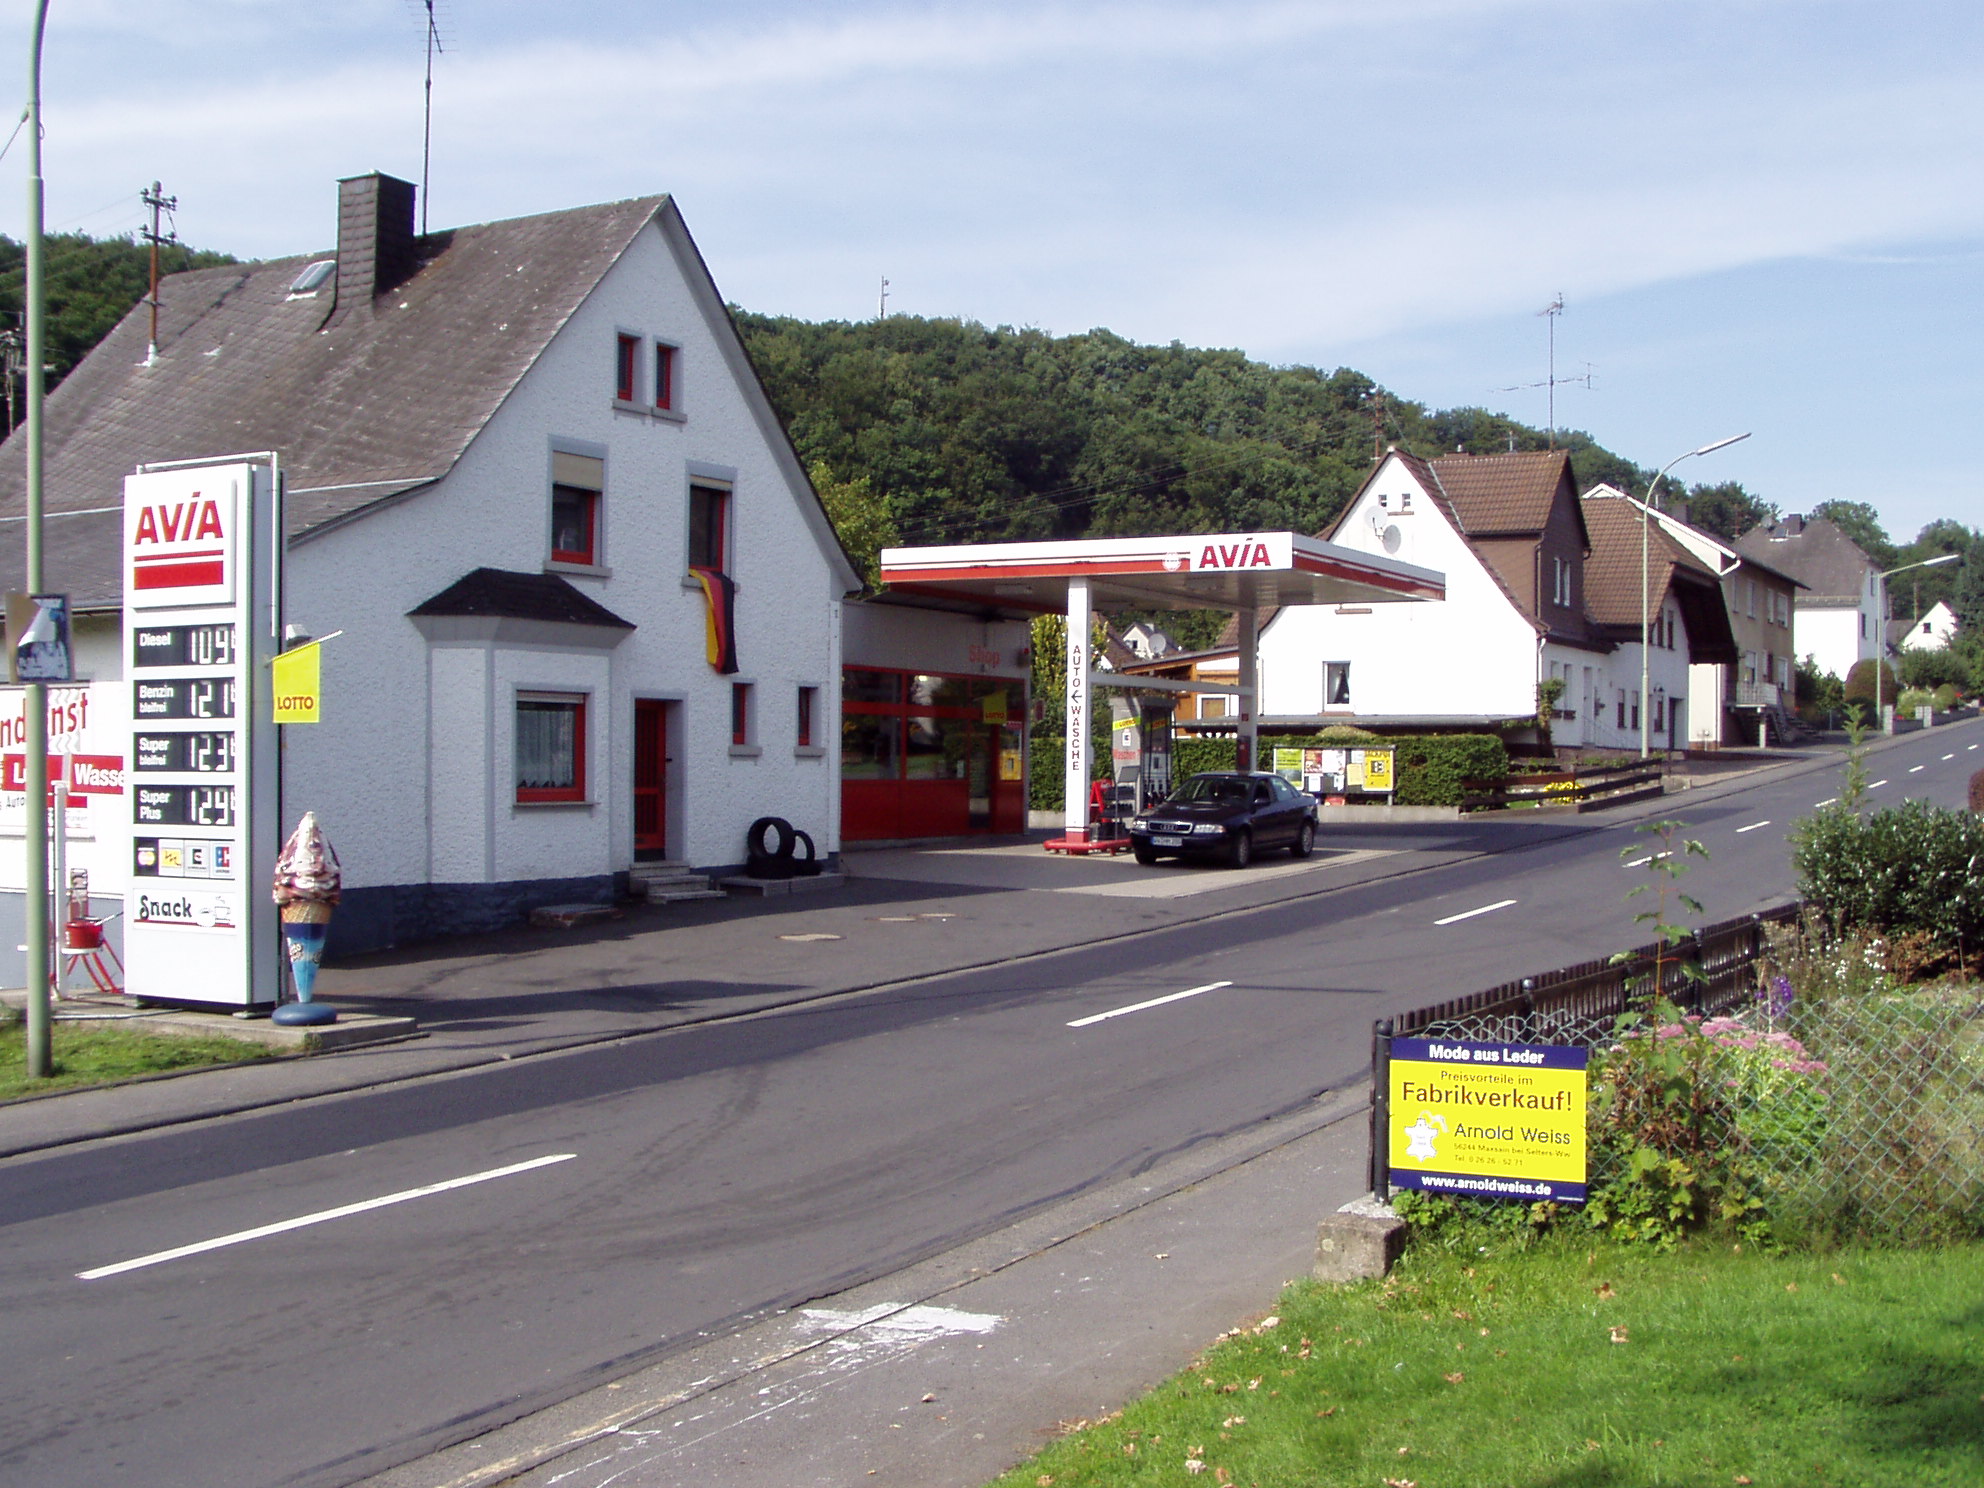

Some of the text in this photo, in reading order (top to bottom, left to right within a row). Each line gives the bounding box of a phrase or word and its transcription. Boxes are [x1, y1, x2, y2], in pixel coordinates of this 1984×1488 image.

[139, 631, 171, 647] Diesel
[1072, 645, 1082, 688] AUTO
[139, 683, 174, 699] Benzin
[277, 696, 314, 710] LOTTO
[139, 737, 170, 753] Super
[140, 789, 171, 806] Super
[140, 806, 162, 820] Plus
[140, 894, 192, 920] Snack
[1429, 1044, 1545, 1065] Mode aus Leder
[1441, 1070, 1533, 1086] Preisvorteile im
[1403, 1081, 1572, 1112] Fabrikverkauf!
[1454, 1123, 1571, 1145] Arnold Weiss
[1421, 1175, 1552, 1196] www.arnoldweiss.de
